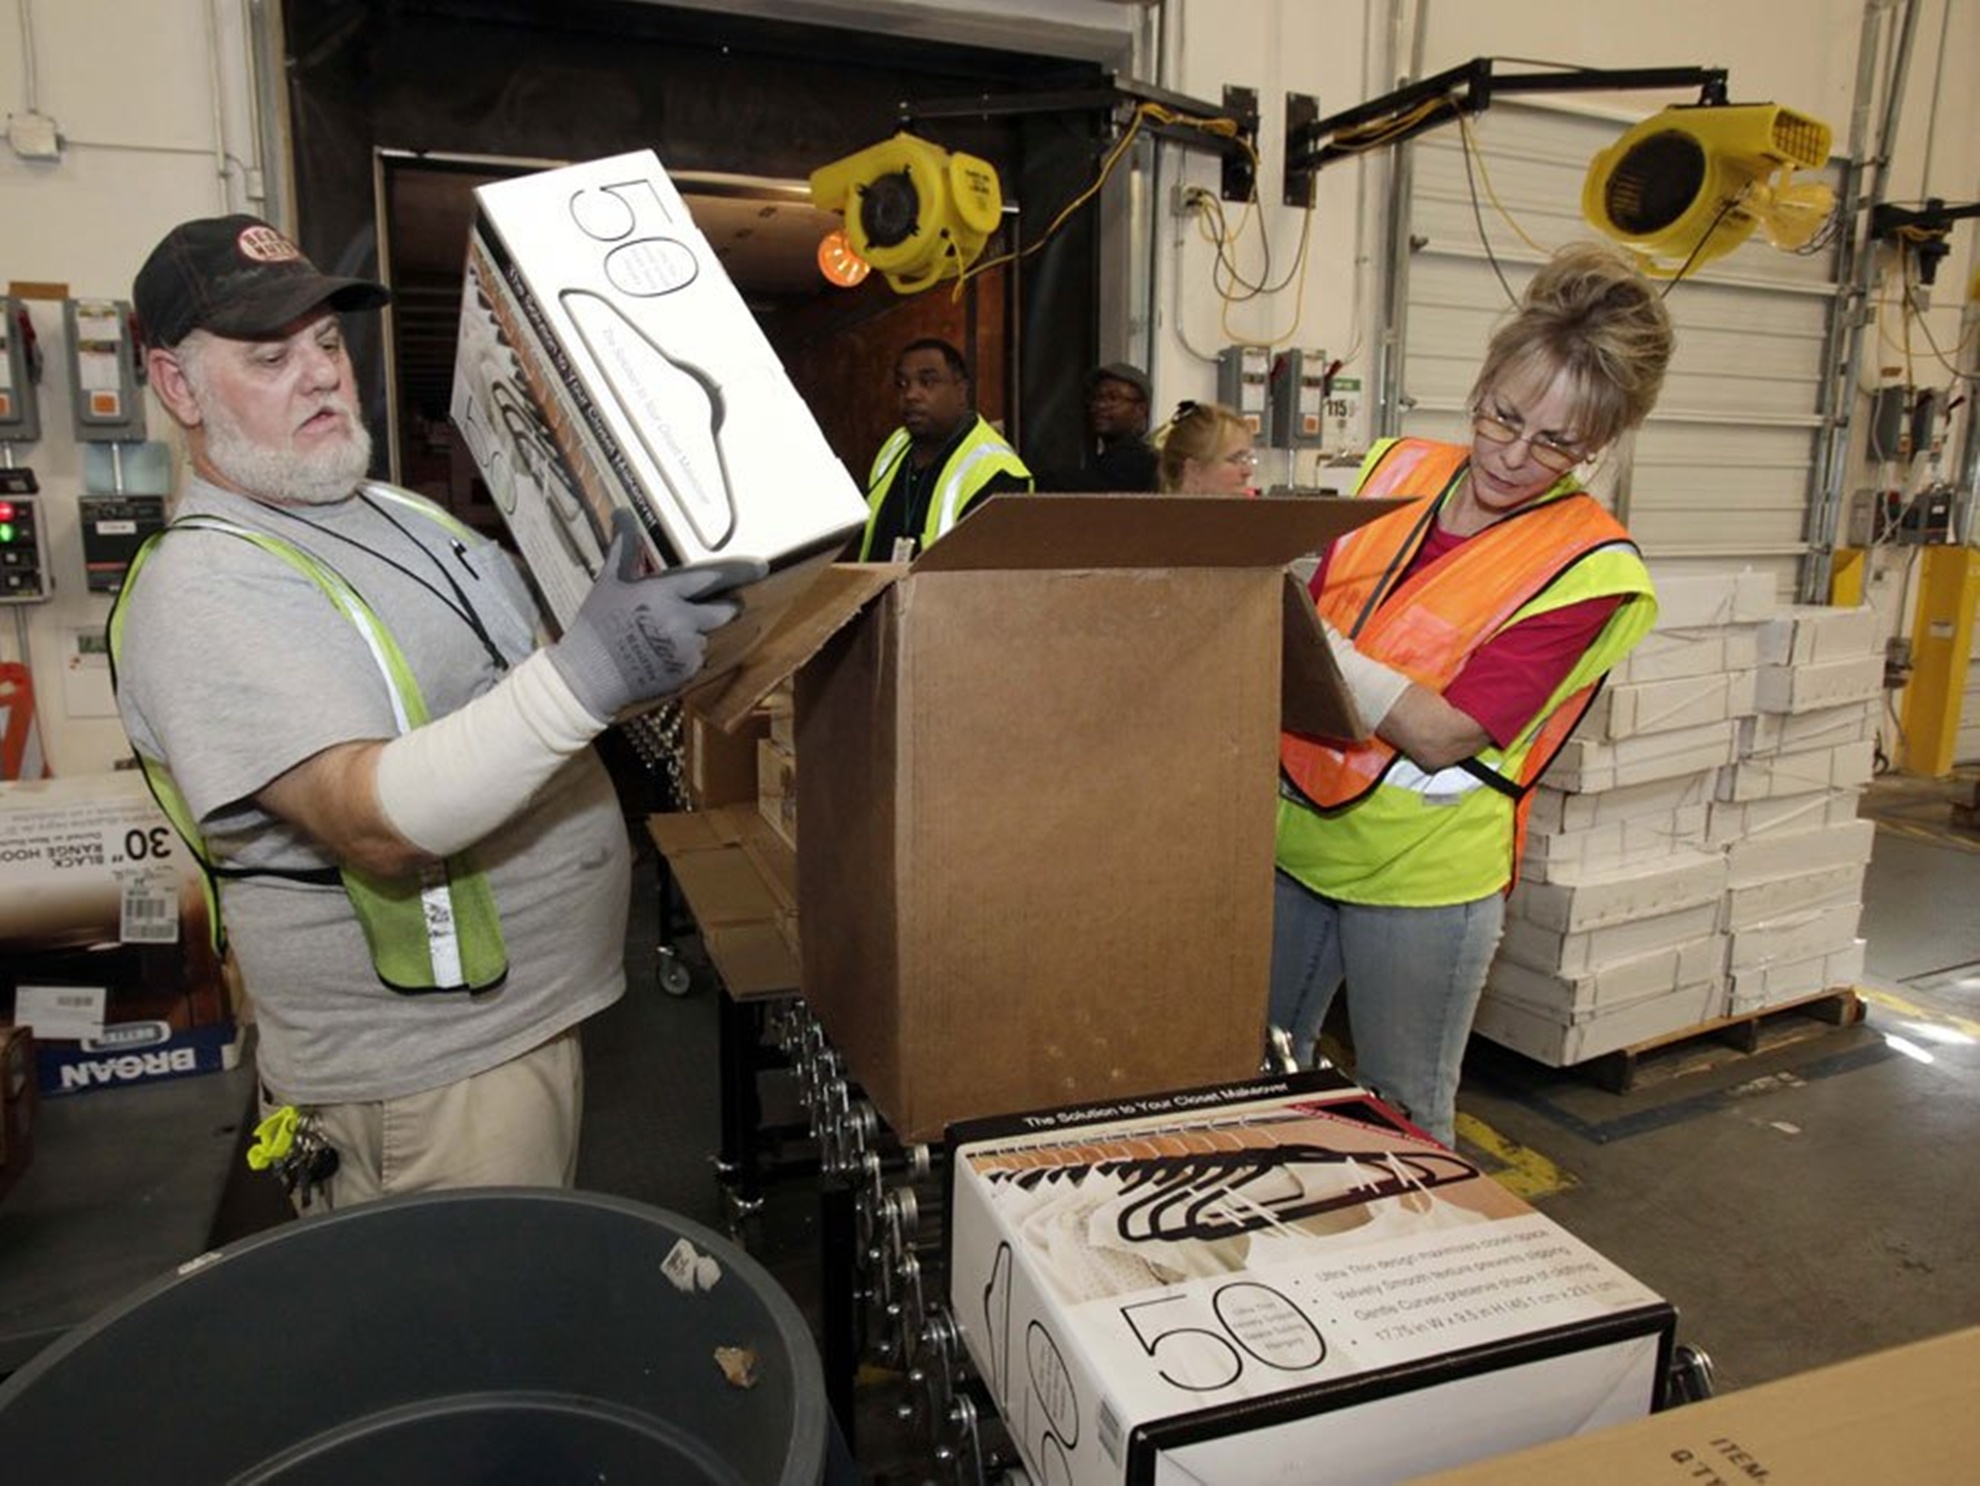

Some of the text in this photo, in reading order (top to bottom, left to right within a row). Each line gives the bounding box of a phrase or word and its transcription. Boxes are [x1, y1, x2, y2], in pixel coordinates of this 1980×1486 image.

[569, 178, 699, 298] 50
[1328, 399, 1347, 417] 115
[0, 843, 104, 862] RANGE HOO
[53, 854, 105, 869] BLACK
[60, 1047, 195, 1089] BROAN
[1022, 1079, 1287, 1129] The Solution to Your Closet Makeover
[1316, 1266, 1347, 1283] Ultra
[1347, 1260, 1375, 1276] Thin
[1382, 1271, 1427, 1291] Smooth
[1353, 1301, 1398, 1321] Gentle
[1397, 1291, 1445, 1312] Curves
[1444, 1280, 1499, 1302] preserve
[1120, 1281, 1328, 1391] 50
[1709, 1438, 1770, 1480] ITEM
